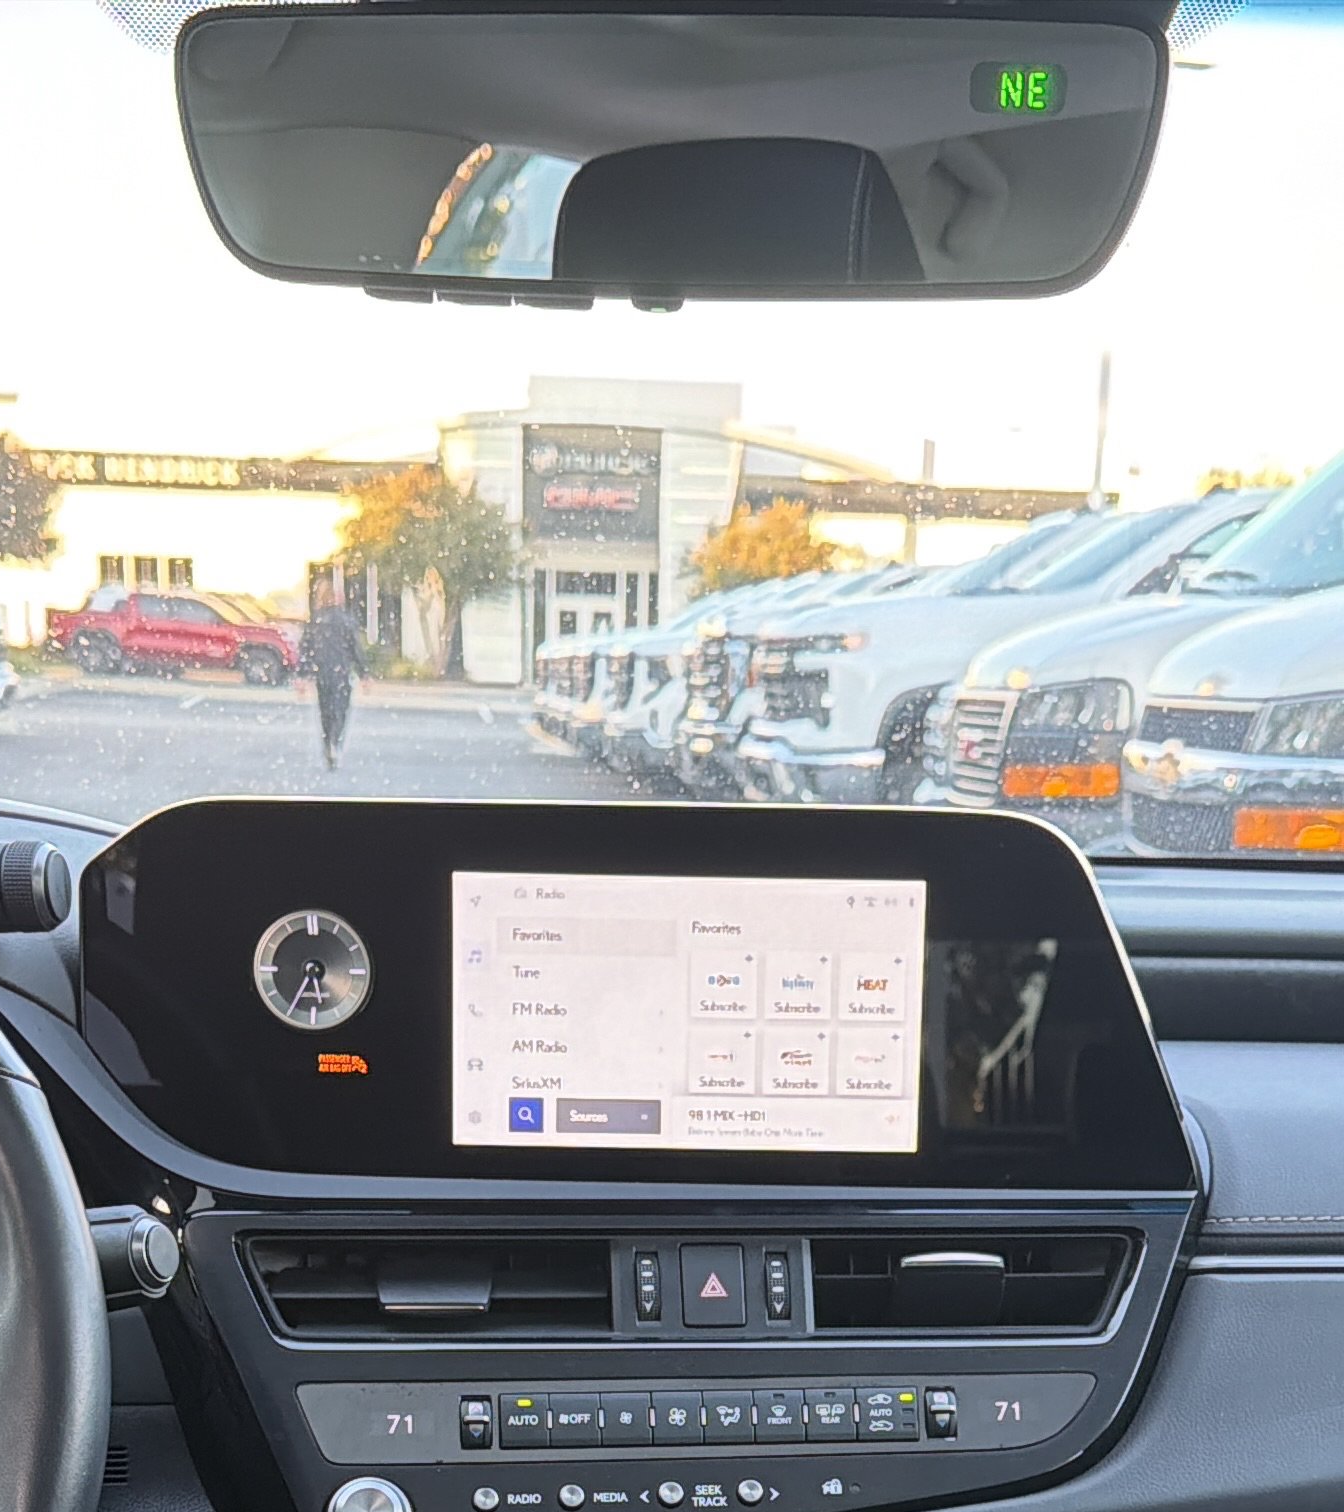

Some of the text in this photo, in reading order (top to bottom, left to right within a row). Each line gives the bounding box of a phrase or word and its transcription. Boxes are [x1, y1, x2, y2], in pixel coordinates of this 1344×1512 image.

[1000, 72, 1048, 109] NE
[536, 888, 565, 899] Radio
[691, 921, 741, 935] Favorites
[512, 928, 562, 941] Favorites
[513, 965, 540, 979] Tune
[857, 979, 888, 991] HEAT
[512, 1002, 567, 1016] FM Radio
[700, 1000, 747, 1012] Subscribe
[774, 1002, 821, 1013] Subscribe
[848, 1003, 895, 1014] Subscribe
[512, 1040, 567, 1053] AM Radio
[512, 1076, 561, 1090] SiriusXM
[570, 1109, 608, 1123] Sources
[869, 1408, 893, 1417] AUTO
[995, 1402, 1021, 1421] 71
[387, 1415, 413, 1434] 71
[508, 1415, 539, 1425] AUTO
[570, 1414, 591, 1424] OFF
[767, 1416, 792, 1425] FRONT
[821, 1415, 840, 1424] REAR
[695, 1485, 722, 1495] SEEK
[507, 1493, 542, 1504] RADIO
[593, 1492, 628, 1503] MEDIA
[691, 1496, 728, 1507] TRACK
